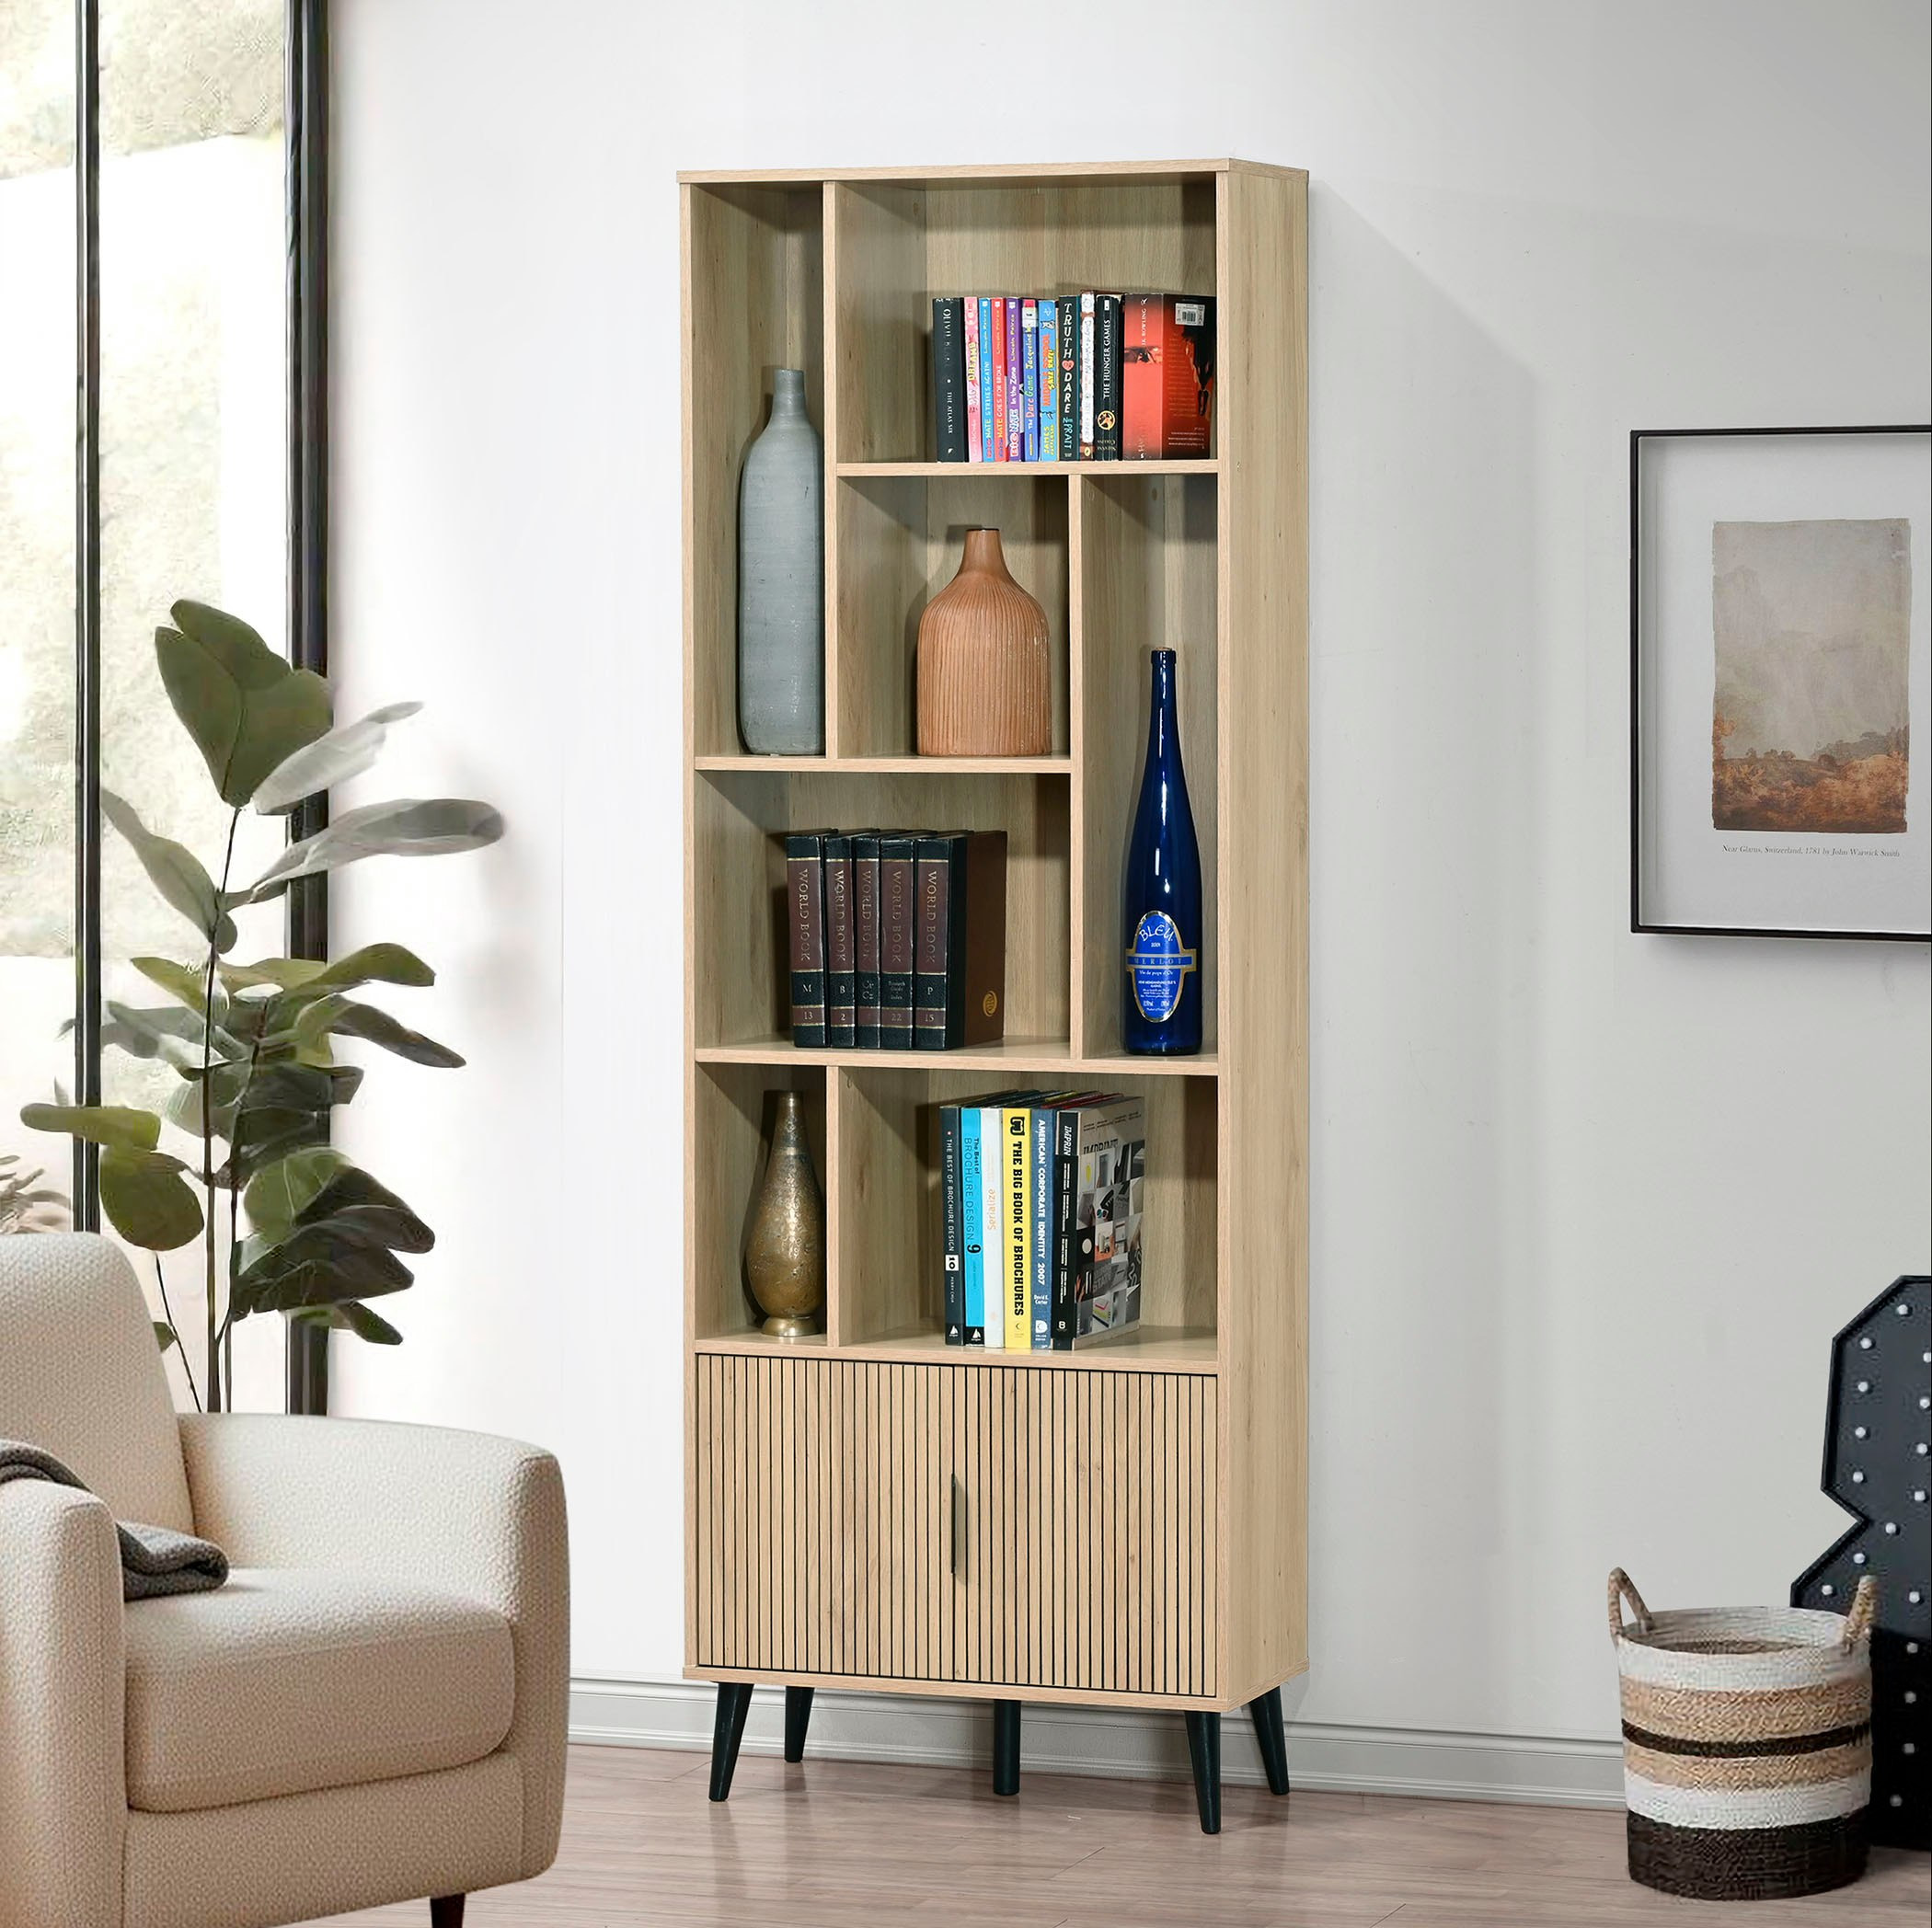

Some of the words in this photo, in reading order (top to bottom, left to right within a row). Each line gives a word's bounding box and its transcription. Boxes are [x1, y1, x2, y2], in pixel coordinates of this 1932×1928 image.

[1064, 303, 1072, 358] TRUTH
[968, 341, 978, 381] DREAMS
[1025, 334, 1034, 369] Jacqueline
[1025, 375, 1034, 397] Game
[1064, 372, 1072, 413] DARE
[1007, 409, 1019, 432] NATE
[1064, 423, 1073, 449] PRATT
[1007, 432, 1019, 457] BIG
[1722, 844, 1738, 853] Near
[1764, 846, 1803, 854] Switzerland,
[1822, 847, 1830, 856] by
[1880, 848, 1900, 857] Smith
[799, 868, 810, 919] WORLD
[834, 870, 845, 920] WORLD
[862, 870, 872, 920] WORLD
[892, 870, 902, 920] WORLD
[928, 871, 937, 920] WORLD
[801, 924, 810, 961] BOOK
[837, 924, 846, 962] BOOK
[862, 924, 872, 960] BOOK
[892, 925, 901, 962] BOOK
[927, 926, 935, 963] BOOK
[802, 984, 812, 993] M
[927, 987, 934, 995] P
[840, 1013, 846, 1021] 2
[925, 1014, 934, 1022] 15
[1013, 1141, 1022, 1165] THE
[1063, 1126, 1072, 1156] IMPRIN
[947, 1174, 953, 1183] OF
[964, 1137, 973, 1196] BROCHURE
[1013, 1169, 1023, 1188] BIG
[966, 1201, 974, 1241] DESIGN
[987, 1188, 997, 1230] Serialize
[1014, 1192, 1023, 1224] BOOK
[967, 1244, 981, 1253] 9
[1014, 1227, 1023, 1242] OF
[949, 1256, 955, 1269] 10
[1014, 1246, 1024, 1316] BROCHURES
